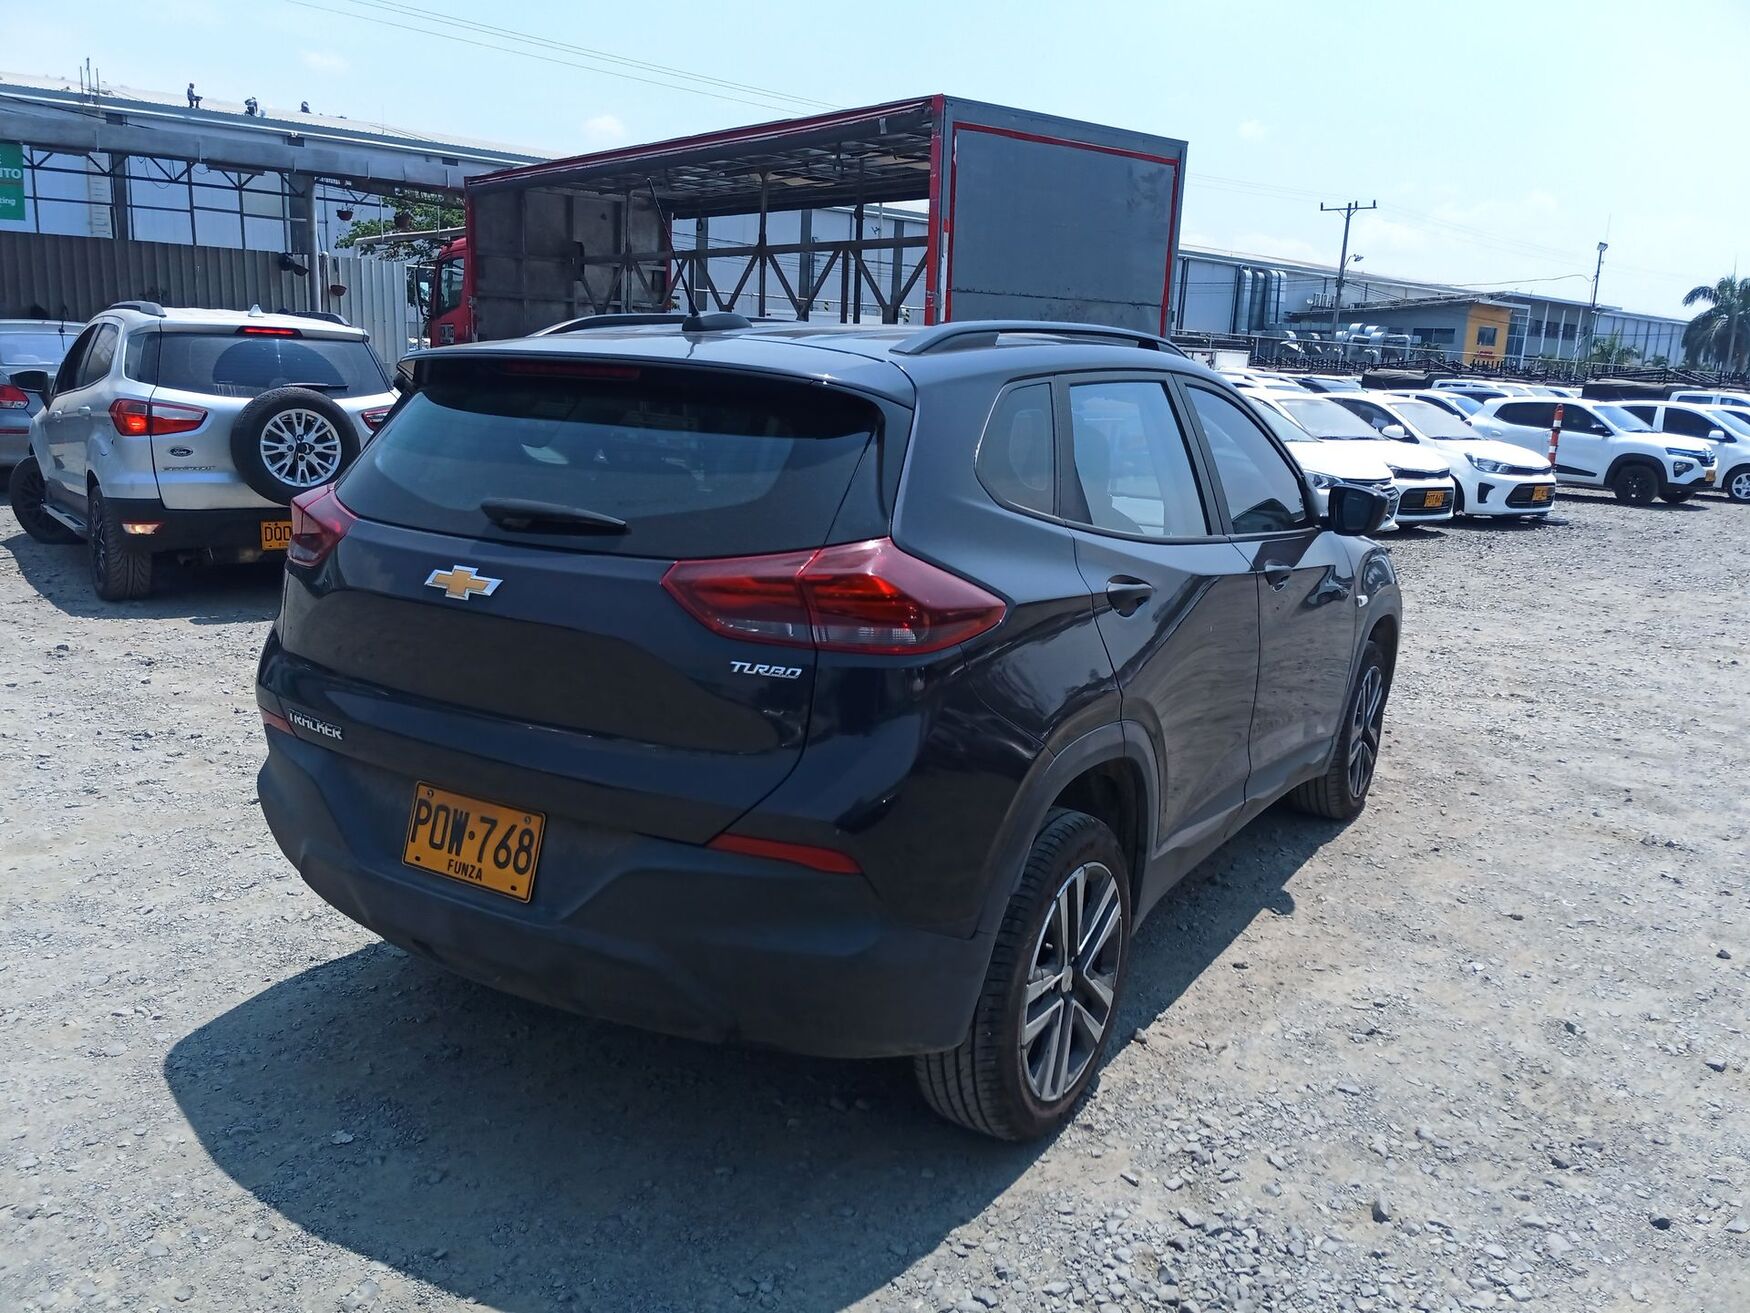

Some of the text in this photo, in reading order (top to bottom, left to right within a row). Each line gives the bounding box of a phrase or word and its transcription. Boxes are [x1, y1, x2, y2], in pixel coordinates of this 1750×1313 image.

[730, 660, 802, 679] TURBO
[288, 708, 343, 740] TRACKER
[447, 859, 483, 882] FUNZA
